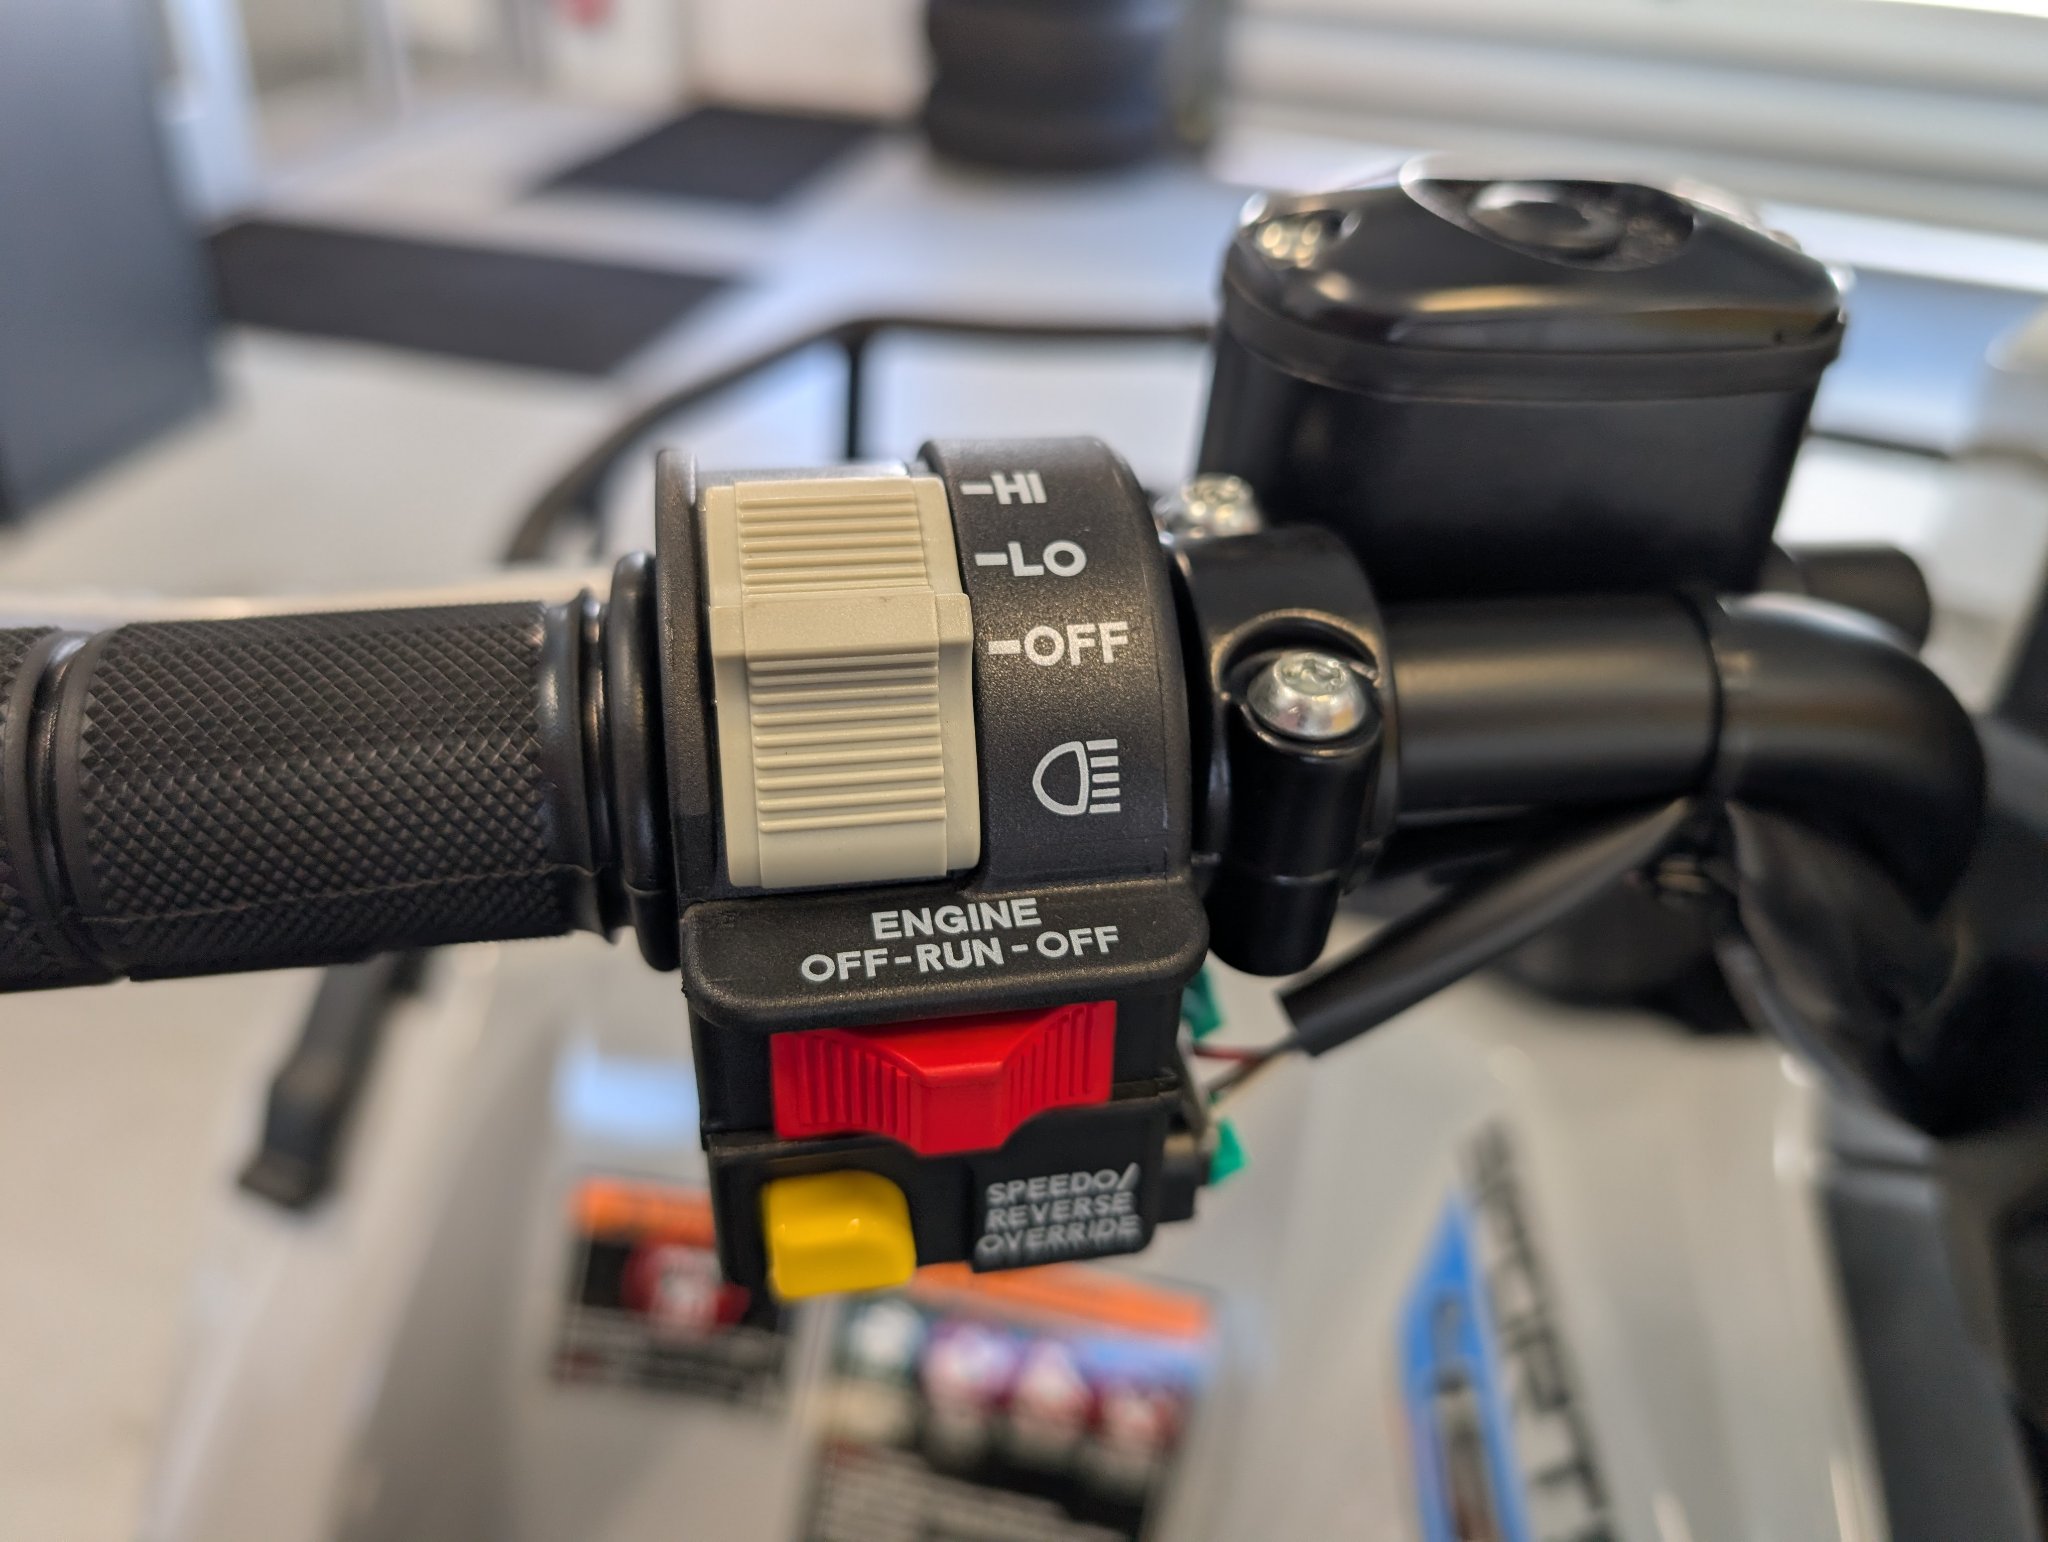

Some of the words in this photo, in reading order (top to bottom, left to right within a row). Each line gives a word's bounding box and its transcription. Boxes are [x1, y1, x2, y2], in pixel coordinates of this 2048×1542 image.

[871, 897, 1042, 940] ENGINE
[986, 1162, 1141, 1203] SPEEDO/
[985, 1191, 1136, 1232] REVERSE
[975, 1214, 1142, 1256] OVERRIDE
